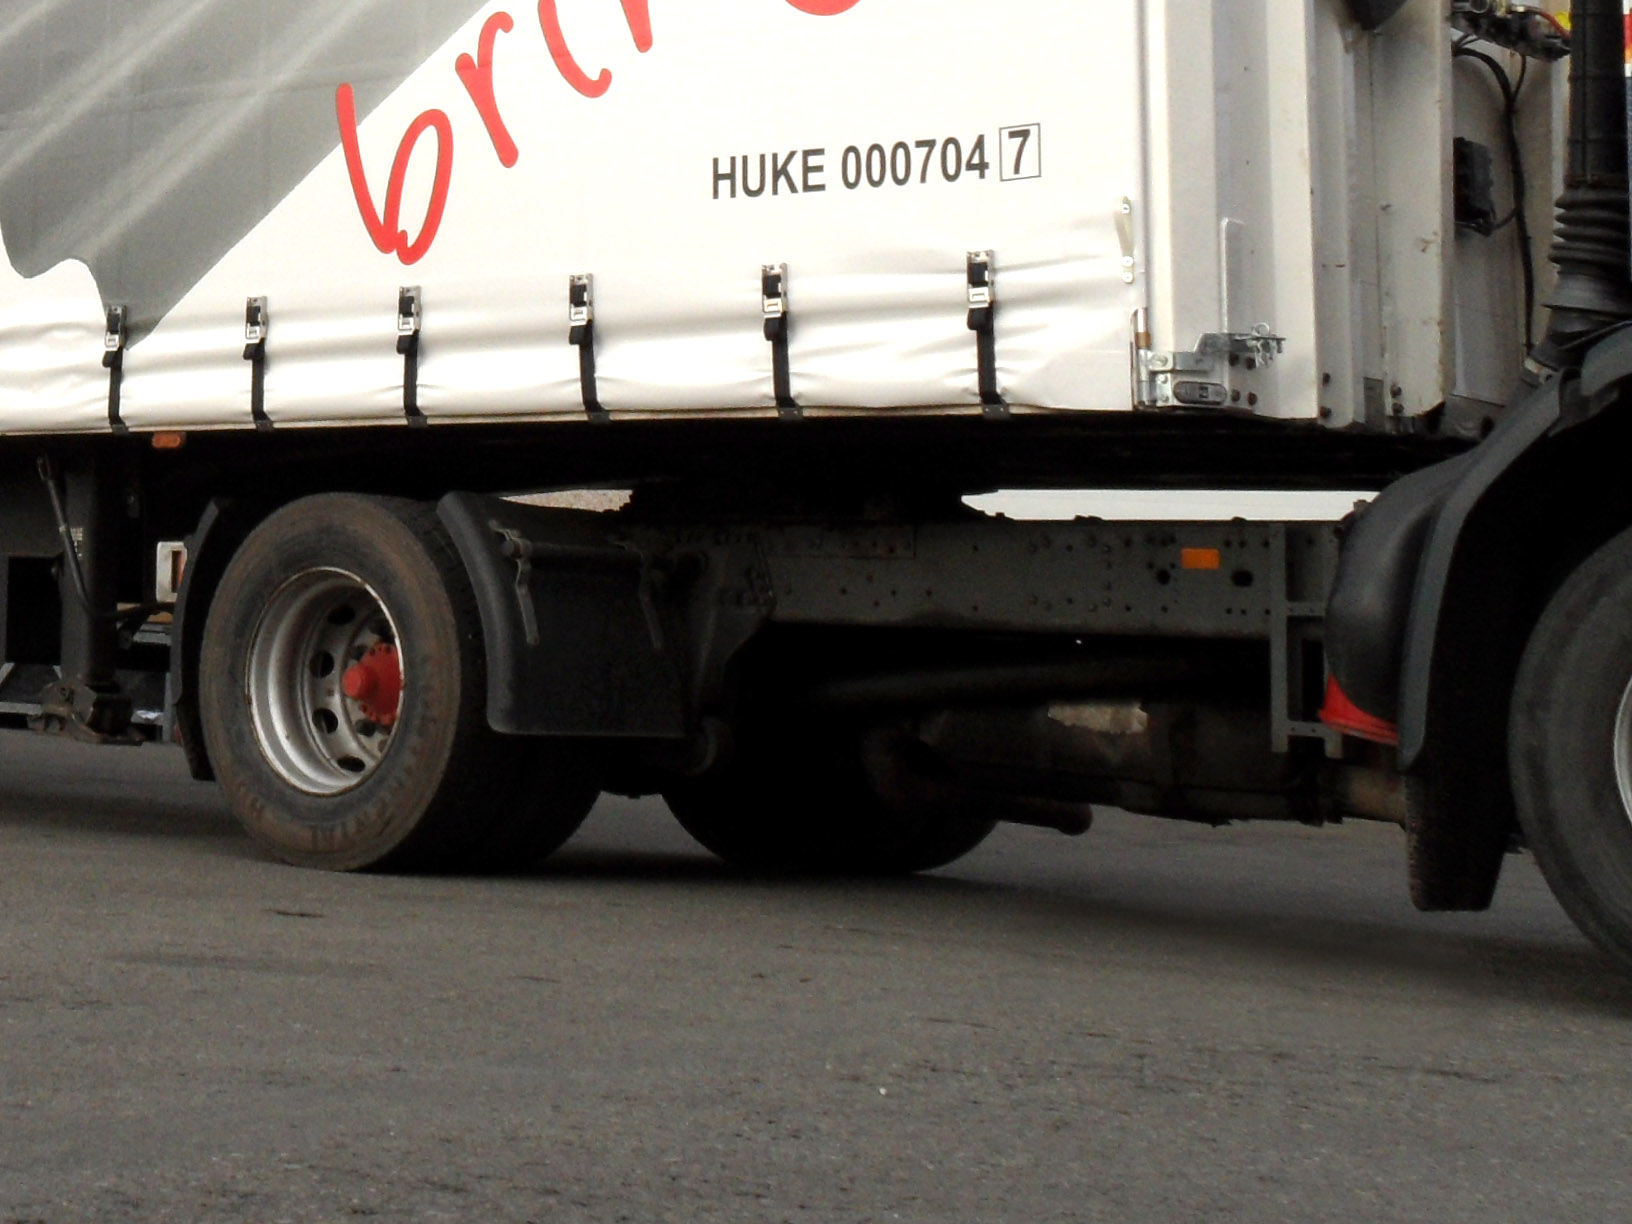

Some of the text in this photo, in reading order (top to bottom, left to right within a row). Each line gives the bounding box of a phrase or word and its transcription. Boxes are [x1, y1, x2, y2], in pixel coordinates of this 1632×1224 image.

[712, 128, 1032, 200] HUKE 000704 7
